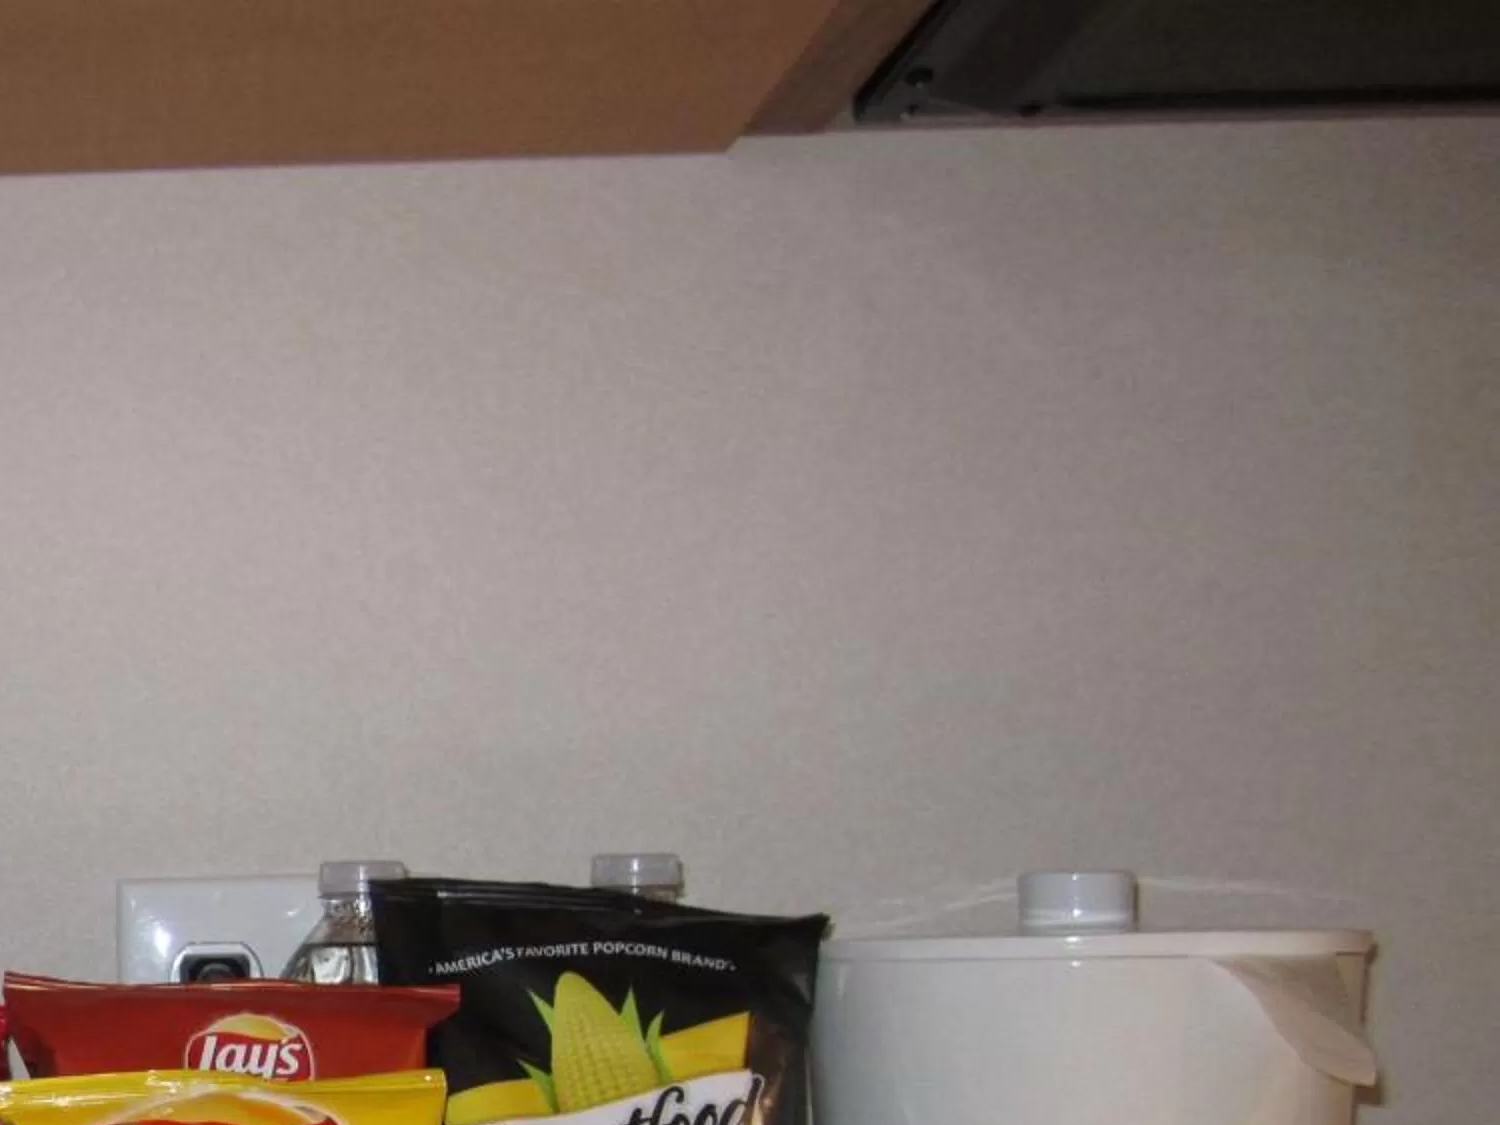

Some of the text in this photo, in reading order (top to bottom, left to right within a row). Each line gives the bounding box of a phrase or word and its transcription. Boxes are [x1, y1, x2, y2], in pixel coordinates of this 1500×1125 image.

[436, 948, 515, 975] AMERICA'S
[516, 942, 588, 959] FAVORITE
[593, 941, 668, 959] POPCORN
[198, 1034, 304, 1079] Lay's
